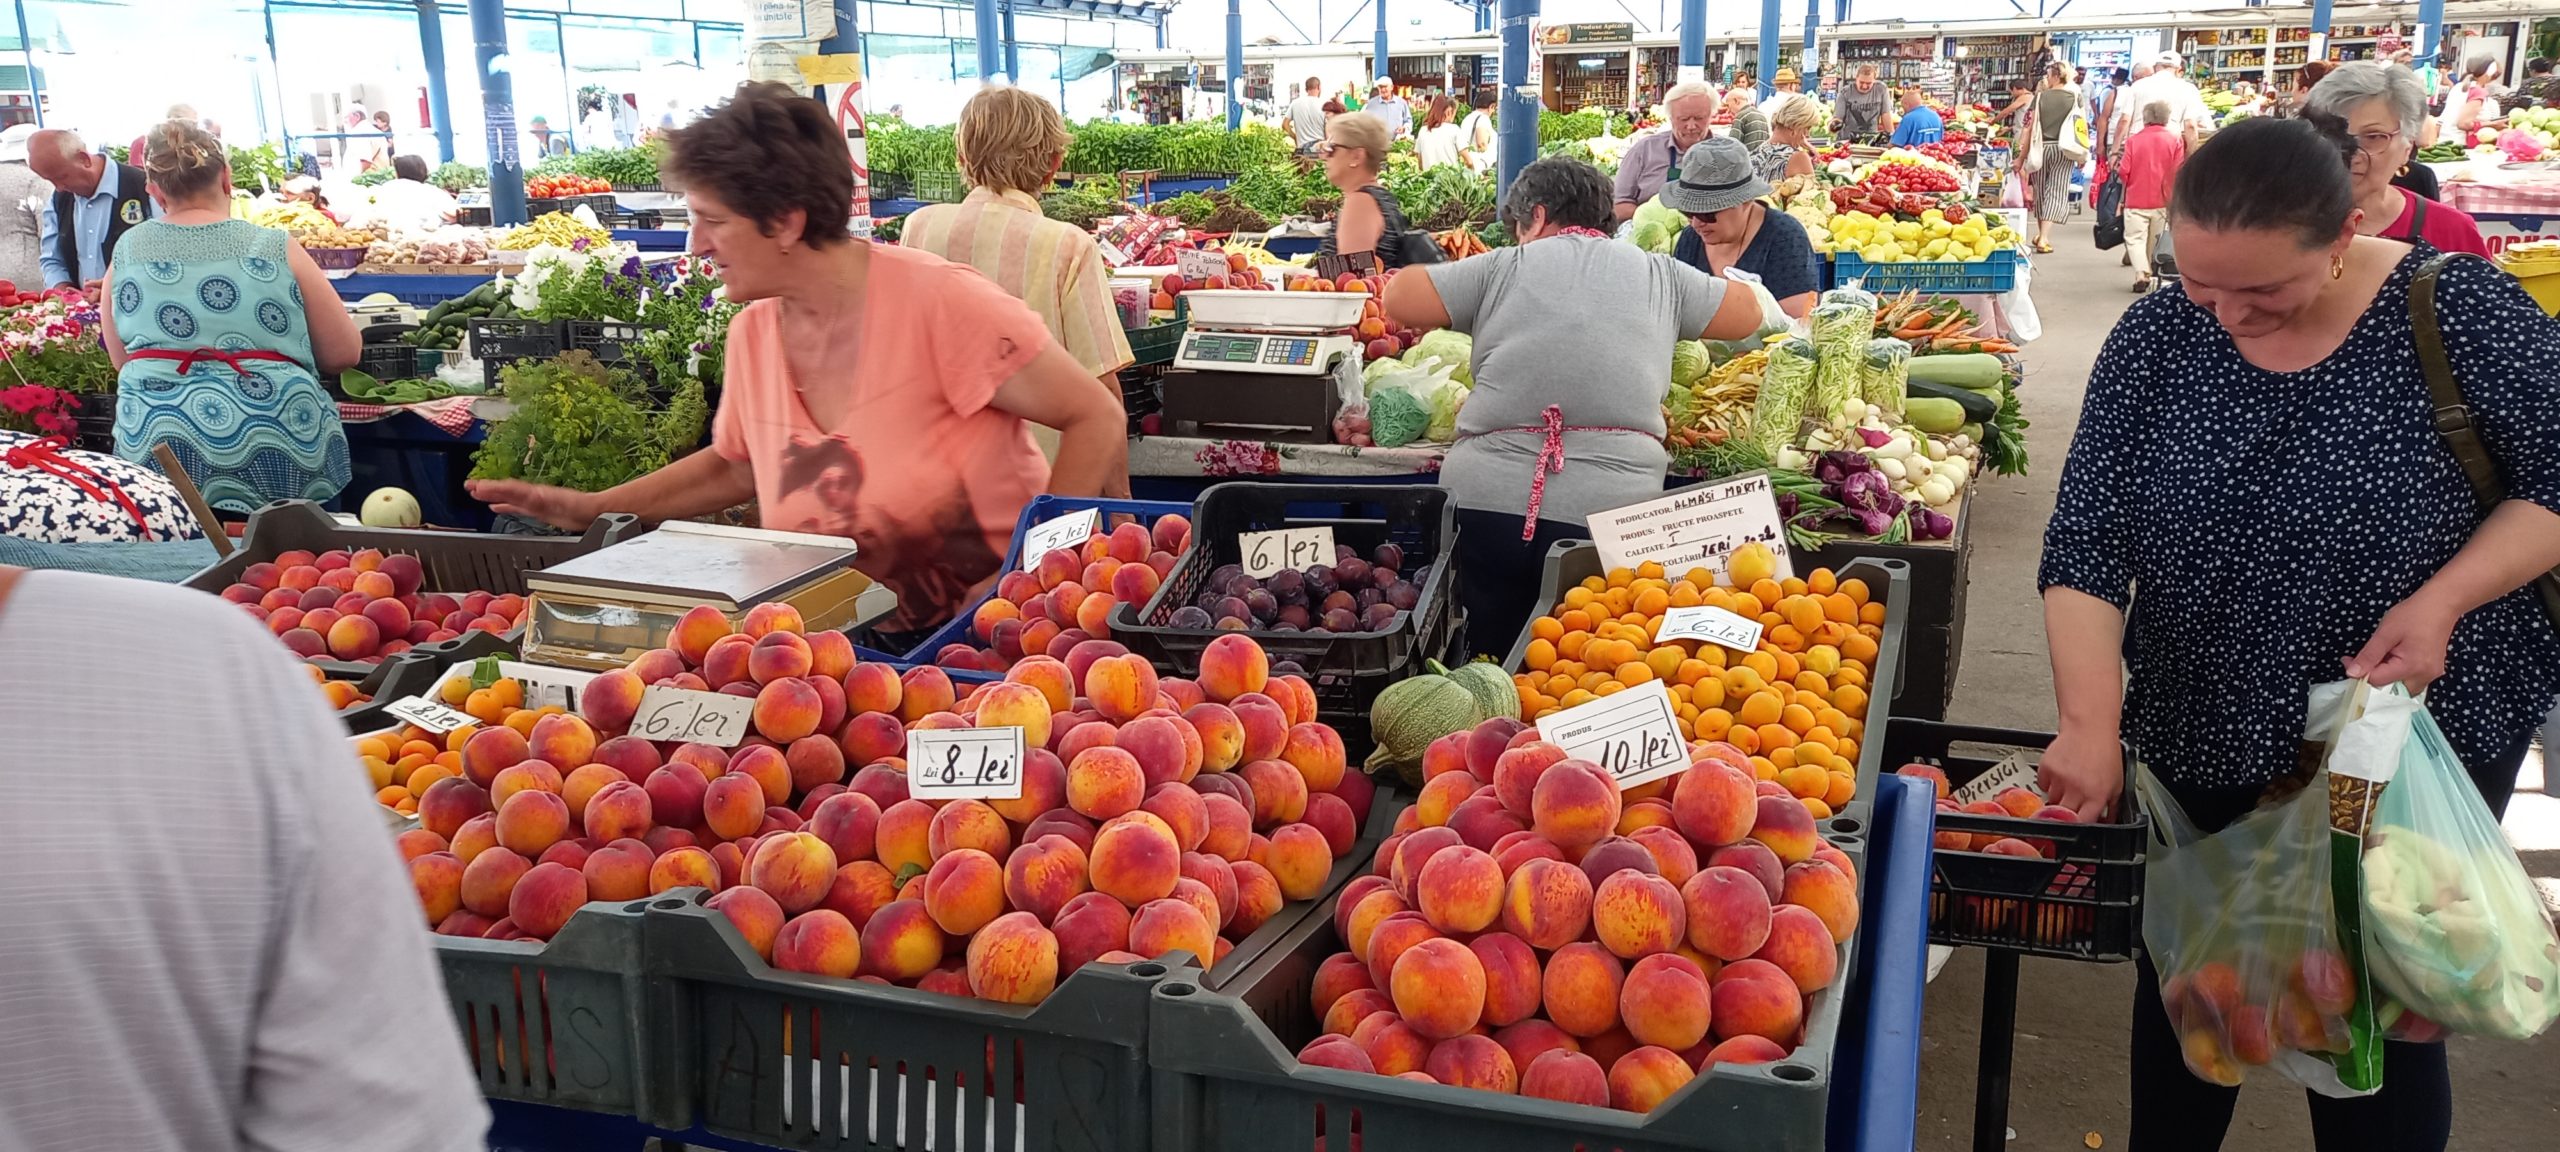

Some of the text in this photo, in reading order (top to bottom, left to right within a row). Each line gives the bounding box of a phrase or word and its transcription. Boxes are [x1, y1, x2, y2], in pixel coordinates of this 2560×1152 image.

[1615, 507, 1673, 526] PRODUCATOR:
[1620, 507, 1745, 542] PRODUS: FRUCTE PROASPETE
[1046, 531, 1061, 548] 5
[1066, 523, 1086, 540] lei
[1562, 725, 1592, 740] PRODUS
[923, 767, 939, 777] Lei
